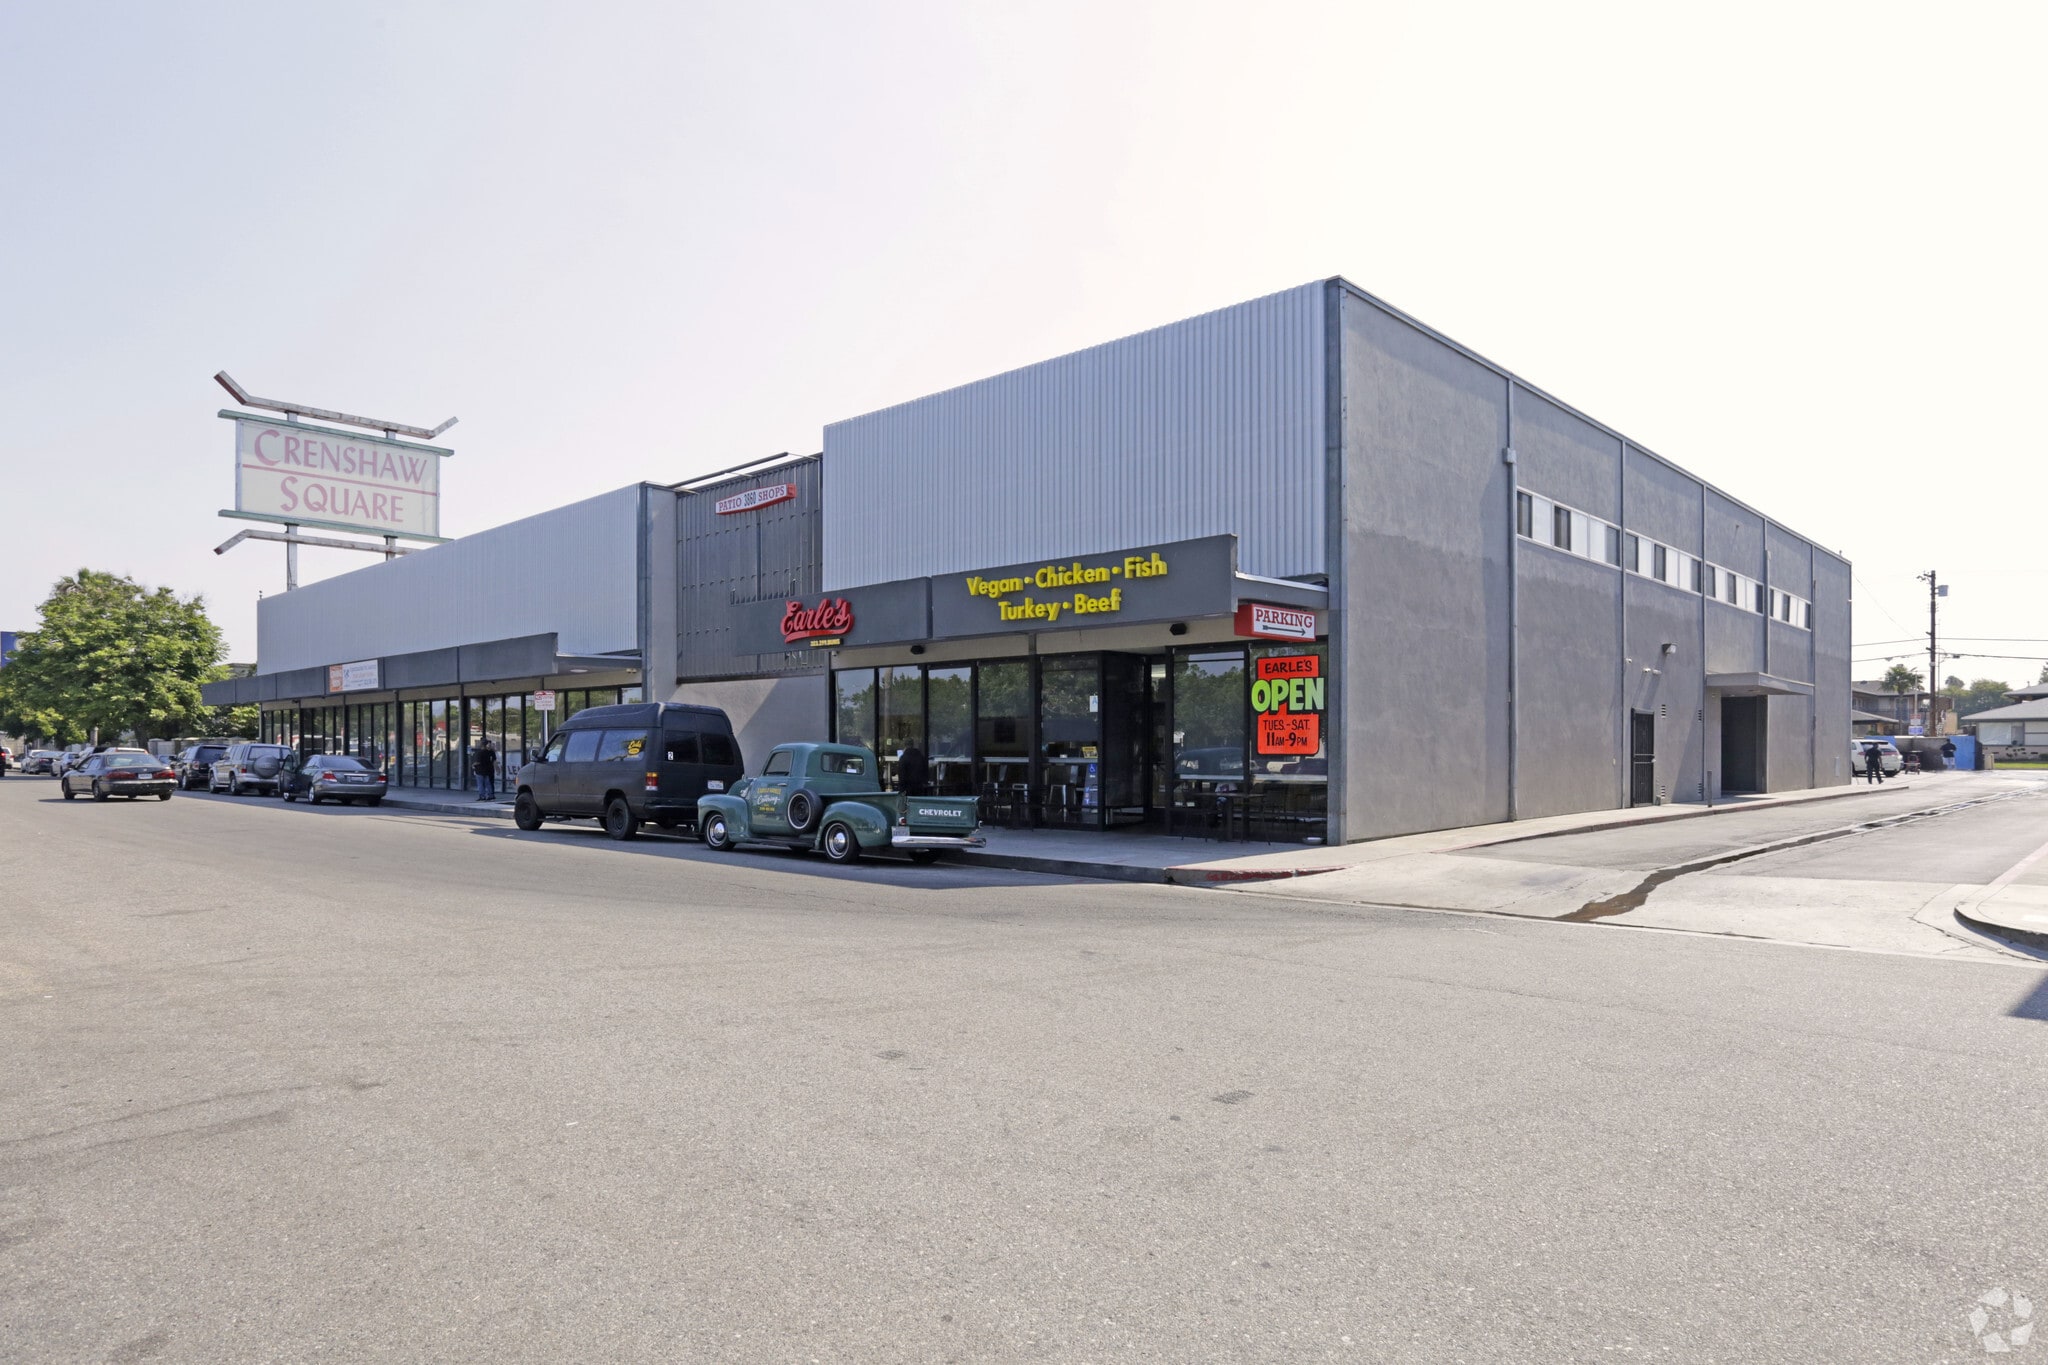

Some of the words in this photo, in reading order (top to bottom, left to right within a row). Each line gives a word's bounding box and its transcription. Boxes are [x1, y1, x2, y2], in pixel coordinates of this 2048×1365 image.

[254, 429, 427, 485] CRENSHAW
[280, 476, 404, 523] SQUARE
[718, 497, 742, 512] PATIO
[758, 485, 785, 502] SHOPS
[966, 576, 1023, 598] Vegan
[1035, 562, 1111, 588] Chicken
[1124, 552, 1168, 578] Fish
[780, 598, 854, 643] Earle's
[998, 597, 1061, 621] Turkey
[1074, 587, 1122, 614] Beef
[1255, 608, 1313, 629] PARKING
[1264, 660, 1313, 674] EARLE'S
[1251, 677, 1325, 713] OPEN
[918, 808, 962, 817] CHEVROLET
